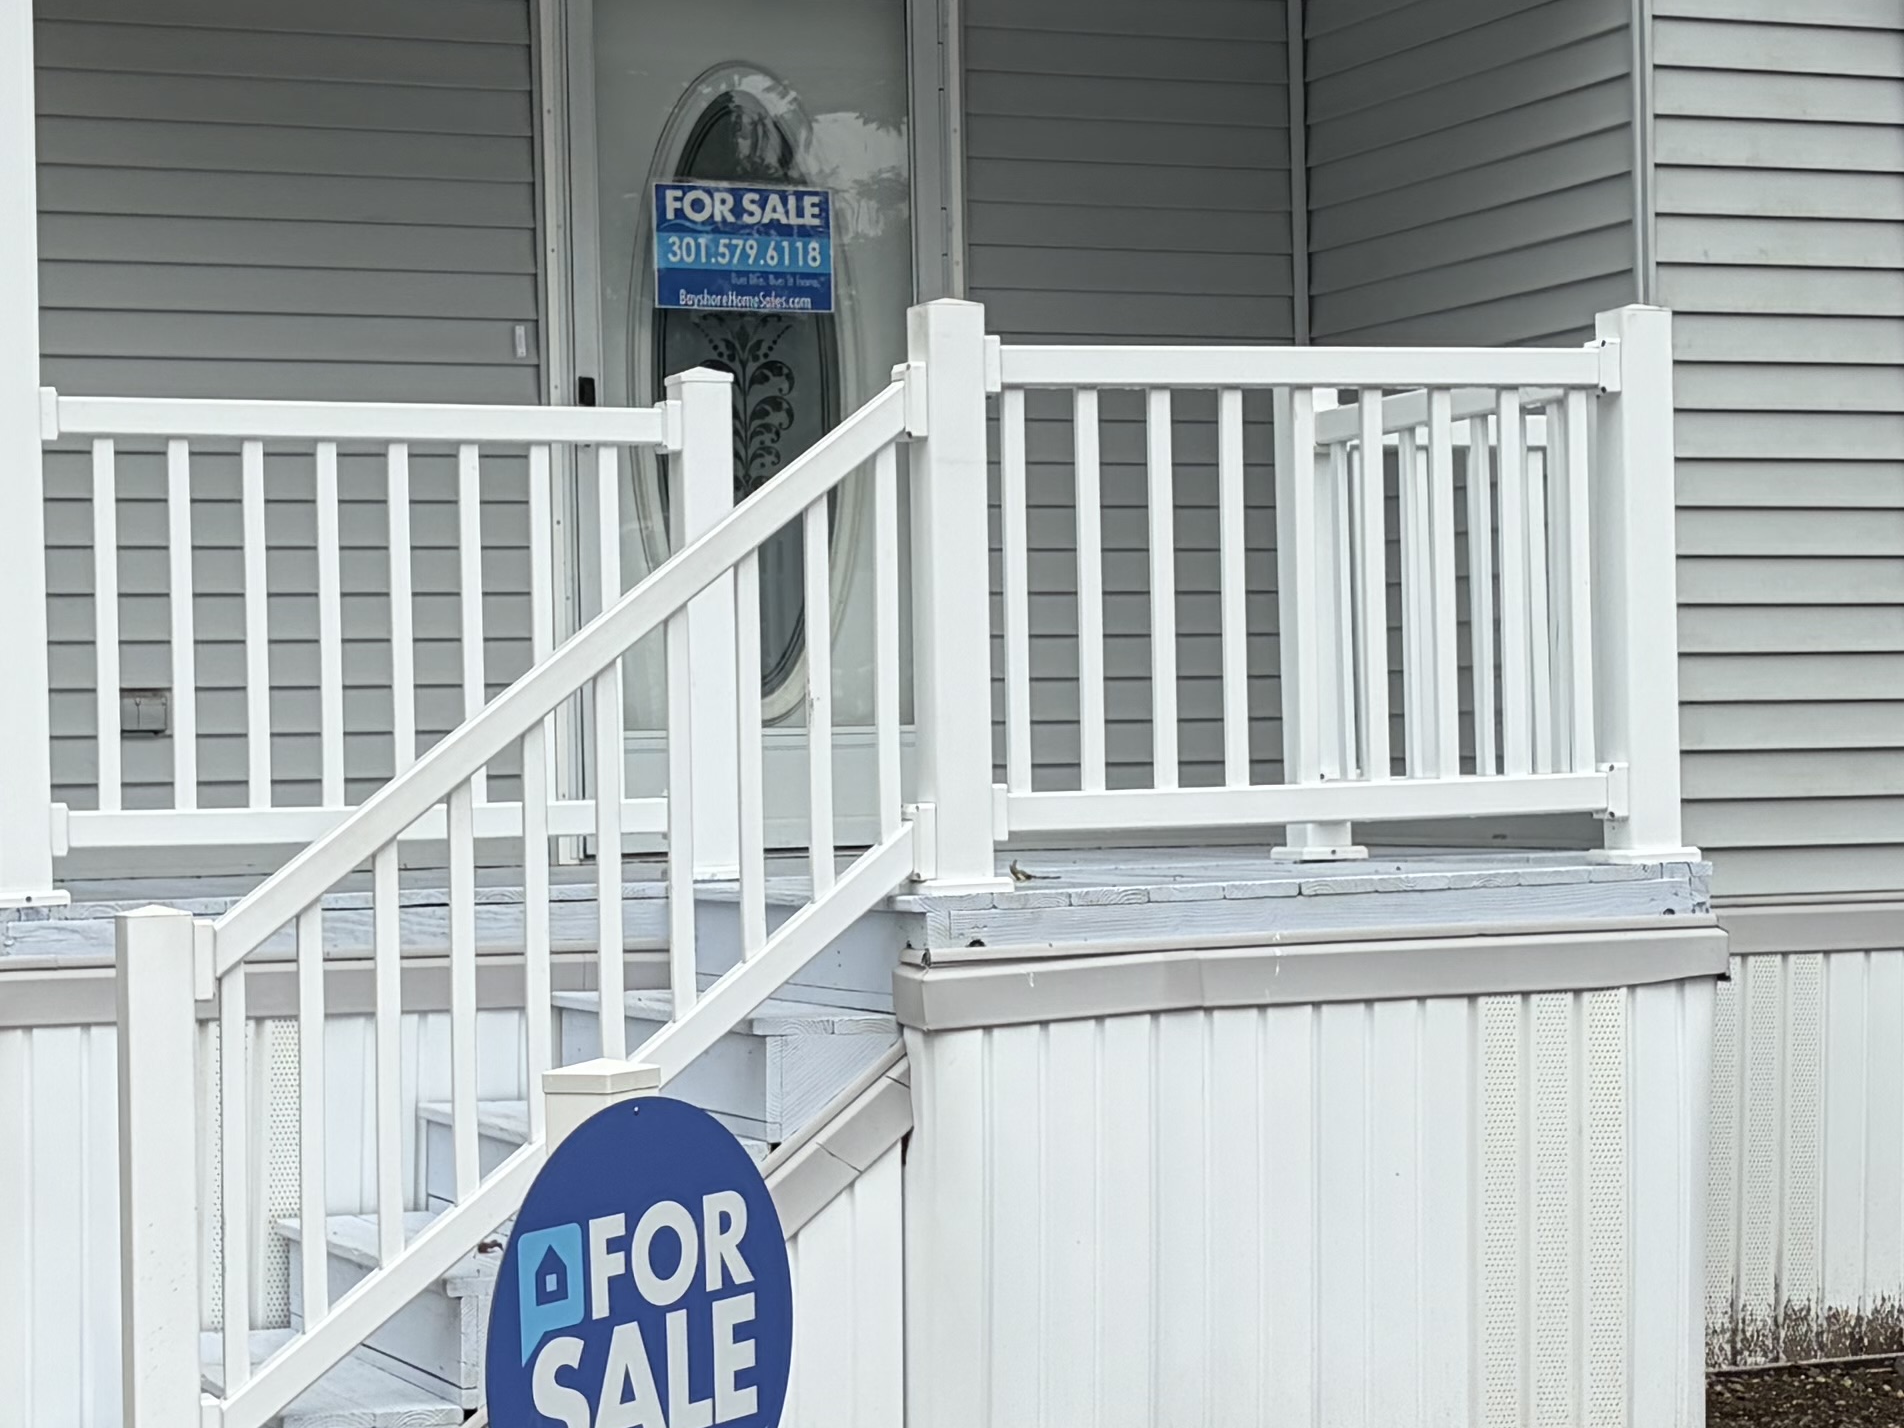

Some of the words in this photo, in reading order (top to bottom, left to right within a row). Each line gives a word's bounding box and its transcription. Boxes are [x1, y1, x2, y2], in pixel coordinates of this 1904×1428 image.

[665, 189, 736, 223] FOR
[742, 192, 821, 225] SALE
[668, 235, 821, 268] 301.579.6118
[679, 288, 812, 310] BayshoreHomeSales.com
[588, 1190, 756, 1321] FOR
